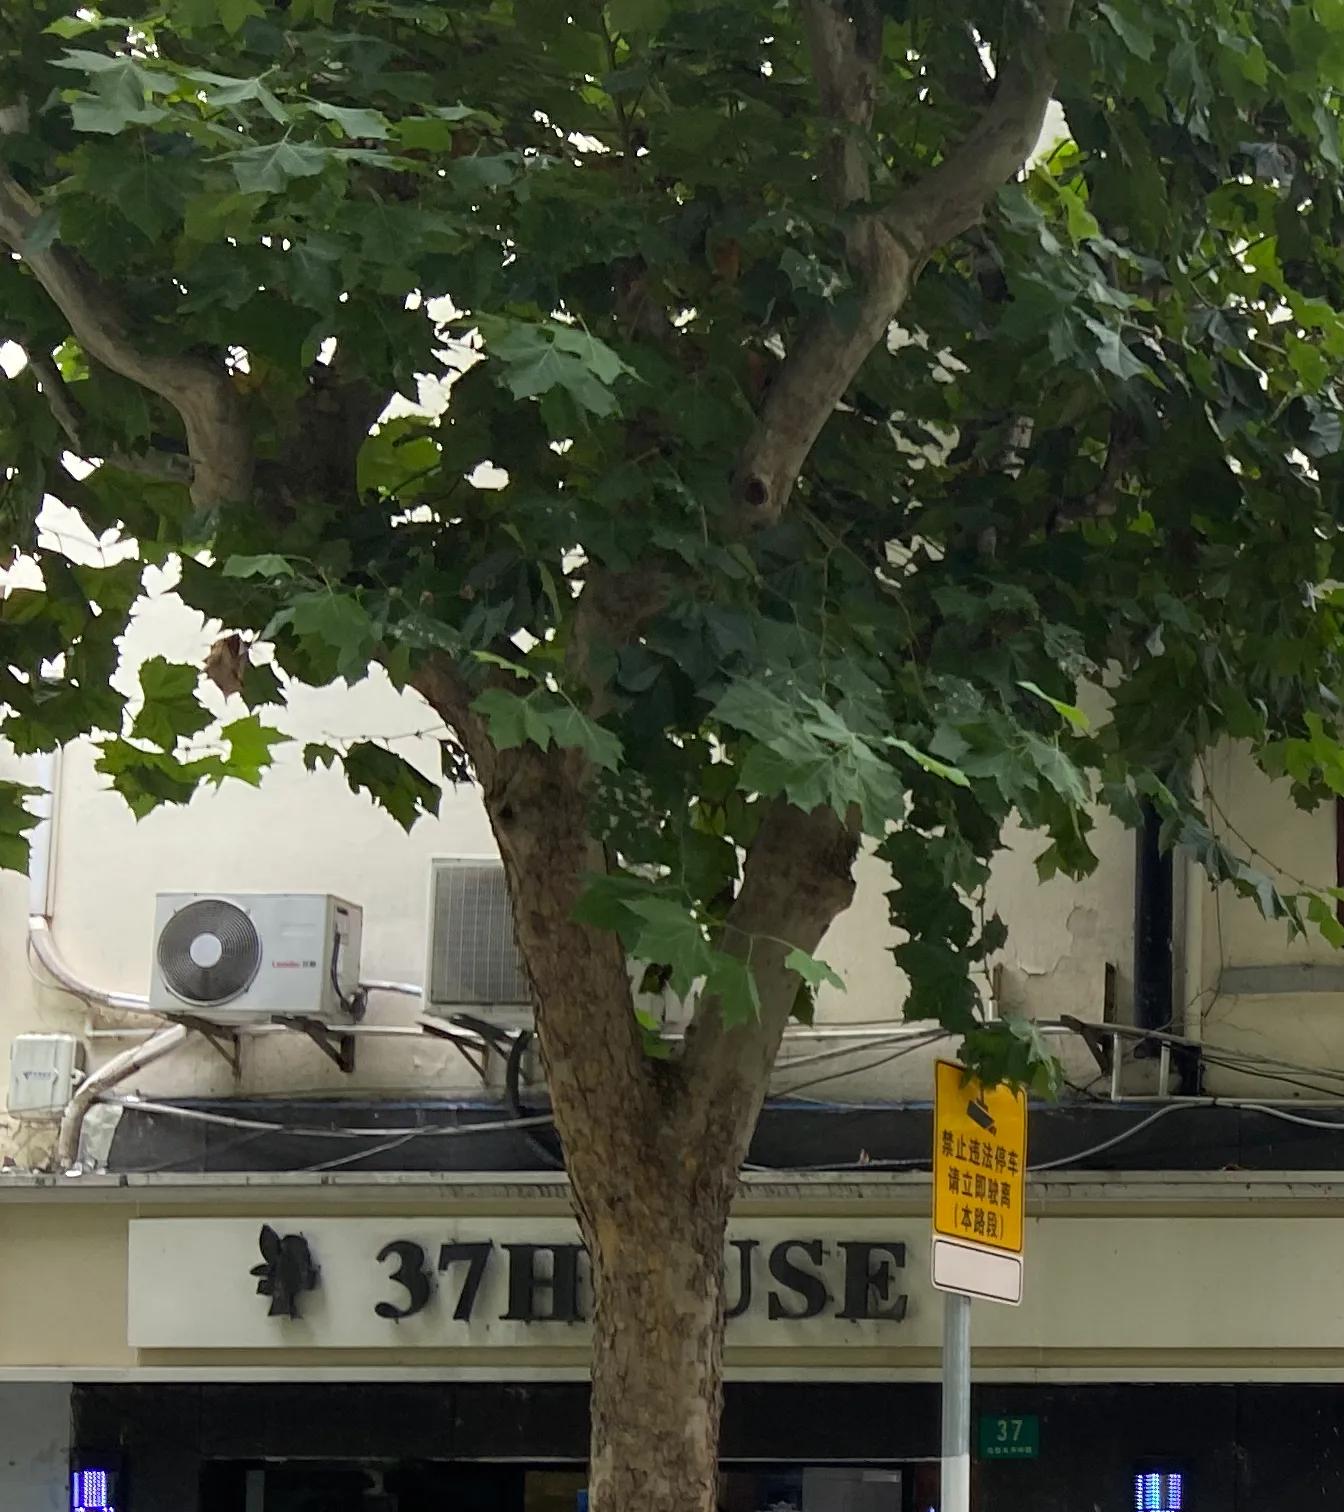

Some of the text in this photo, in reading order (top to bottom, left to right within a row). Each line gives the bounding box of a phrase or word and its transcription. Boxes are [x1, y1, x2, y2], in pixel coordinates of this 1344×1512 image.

[942, 1129, 1018, 1177] 禁止违法停车
[947, 1165, 1011, 1209] 请立即驶离
[374, 1239, 909, 1321] 37HSE
[996, 1418, 1024, 1442] 37
